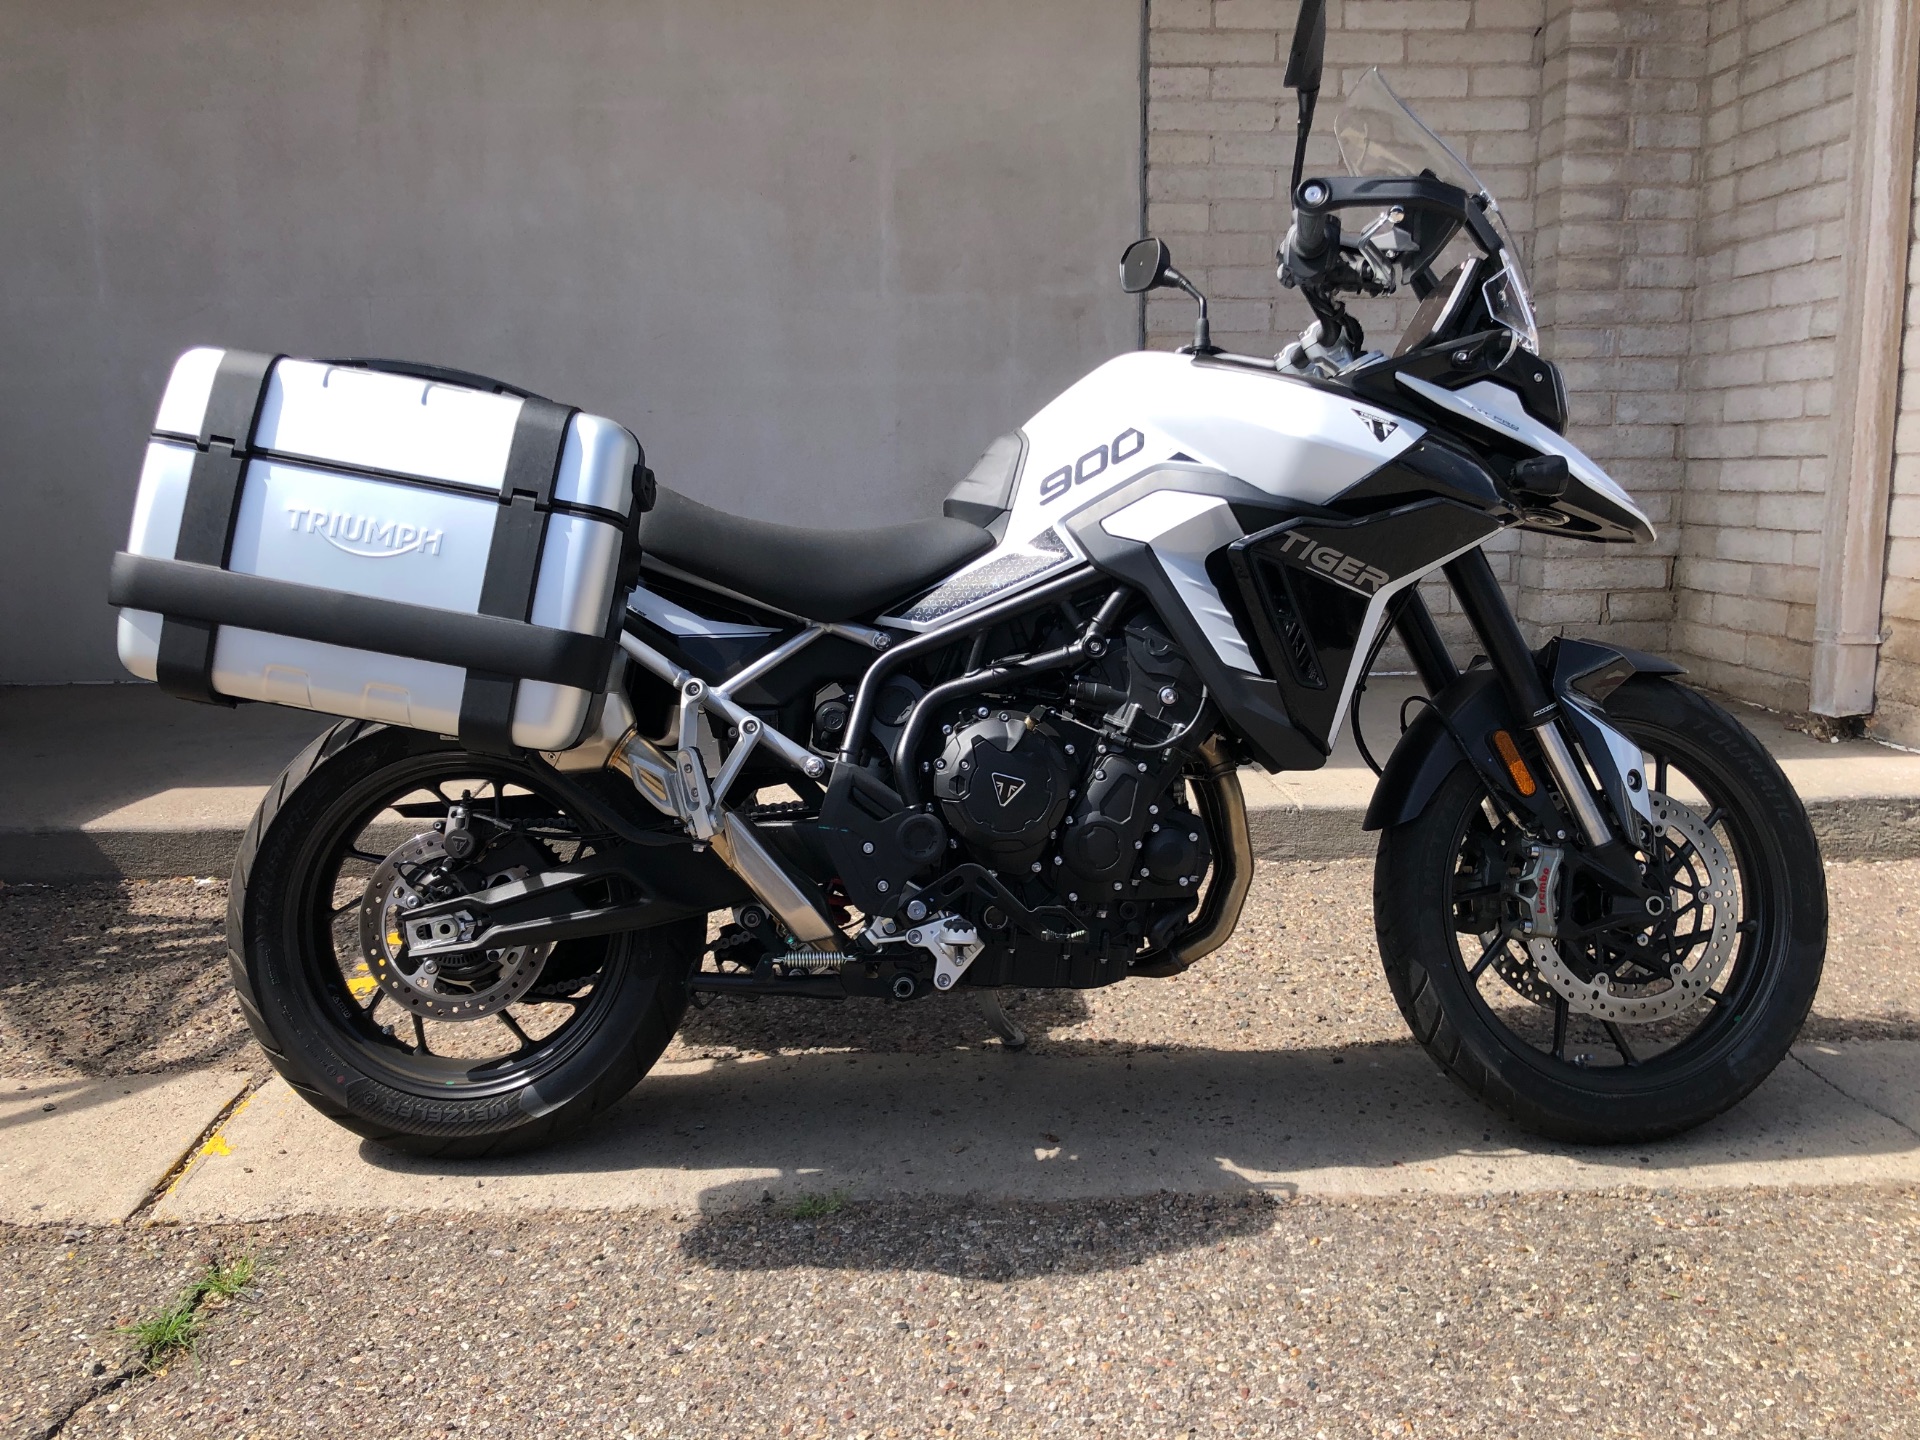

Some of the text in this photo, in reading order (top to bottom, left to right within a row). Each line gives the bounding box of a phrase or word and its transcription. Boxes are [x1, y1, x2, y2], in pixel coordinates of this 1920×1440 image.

[1040, 427, 1145, 506] 900
[287, 507, 443, 556] TRIUMPH
[1279, 530, 1390, 592] TIGER
[1537, 867, 1550, 914] brembo
